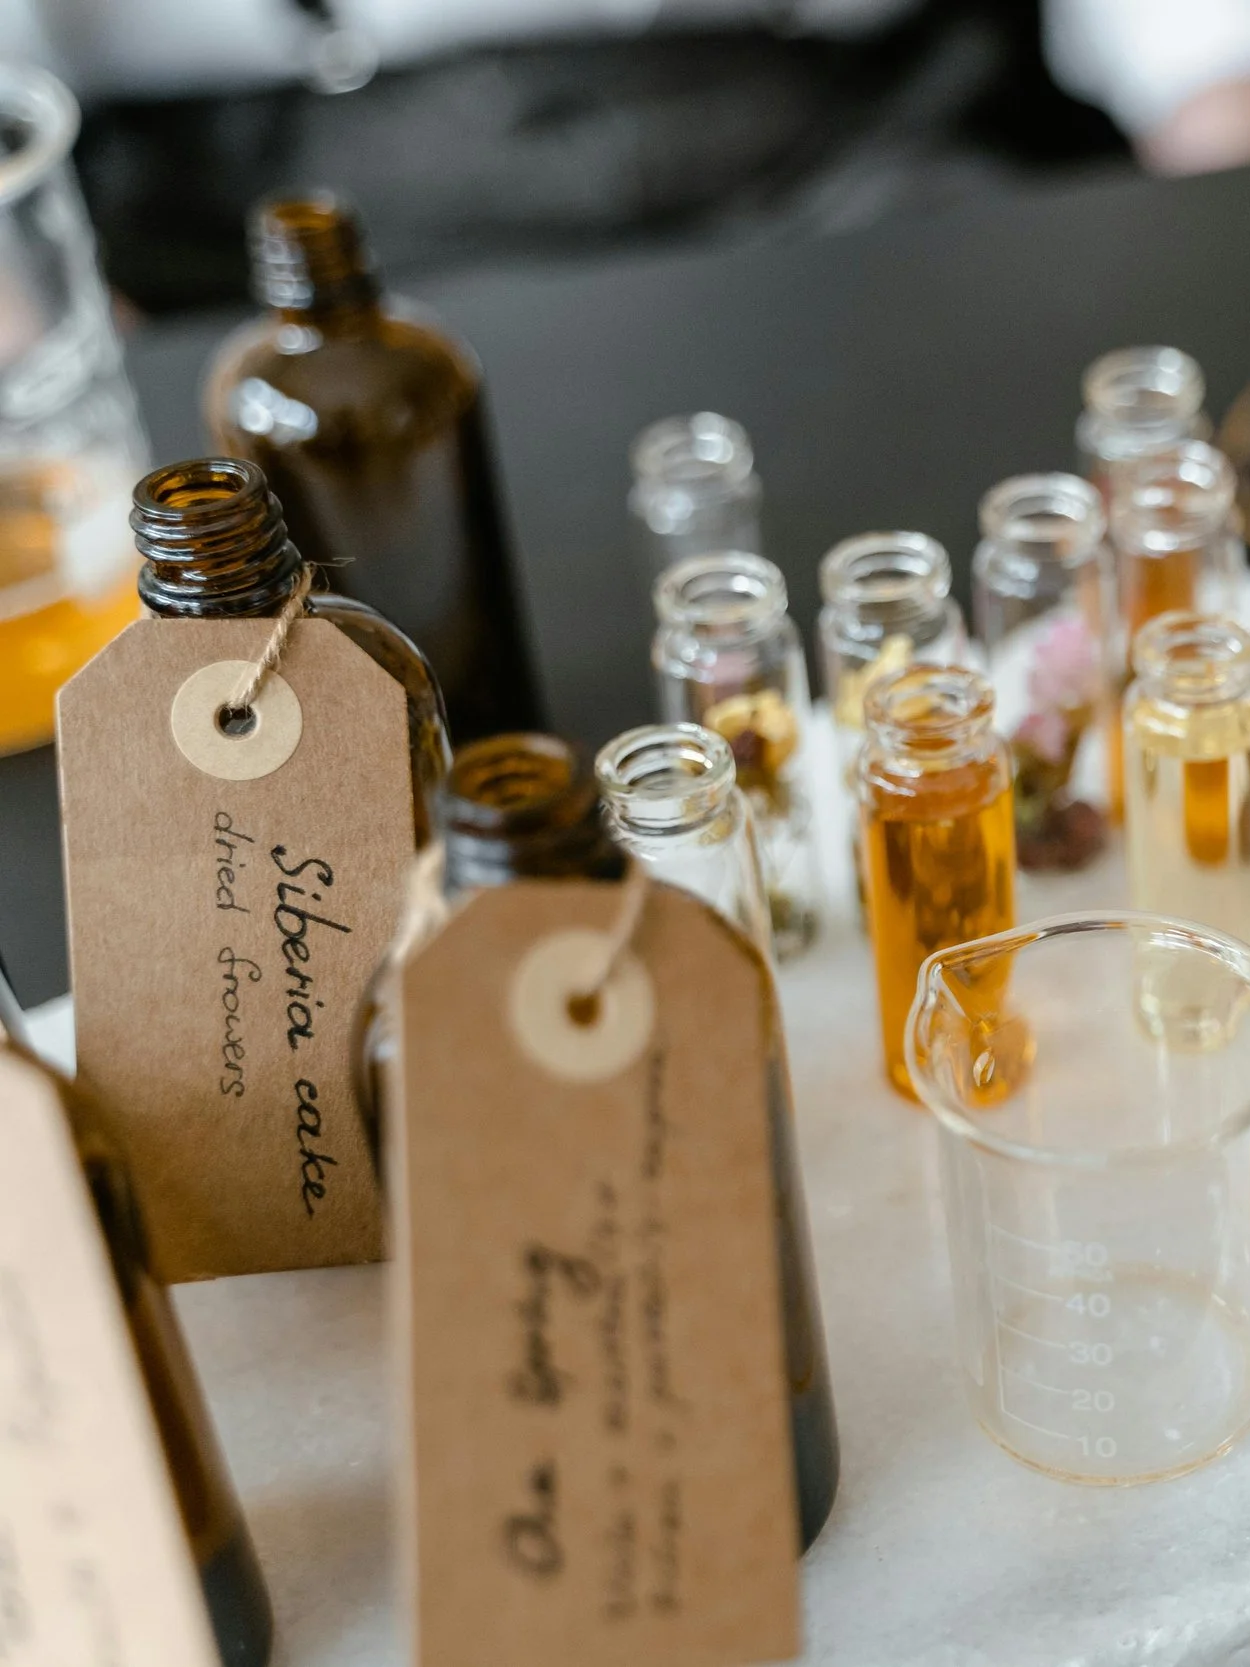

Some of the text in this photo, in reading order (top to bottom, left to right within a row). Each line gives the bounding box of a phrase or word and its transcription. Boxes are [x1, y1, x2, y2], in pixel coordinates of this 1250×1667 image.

[214, 811, 255, 914] dried
[270, 845, 353, 1217] Siberia cake
[1065, 1293, 1111, 1318] 40
[1068, 1342, 1113, 1366] 30
[1071, 1389, 1115, 1412] 20
[1075, 1436, 1117, 1458] 10
